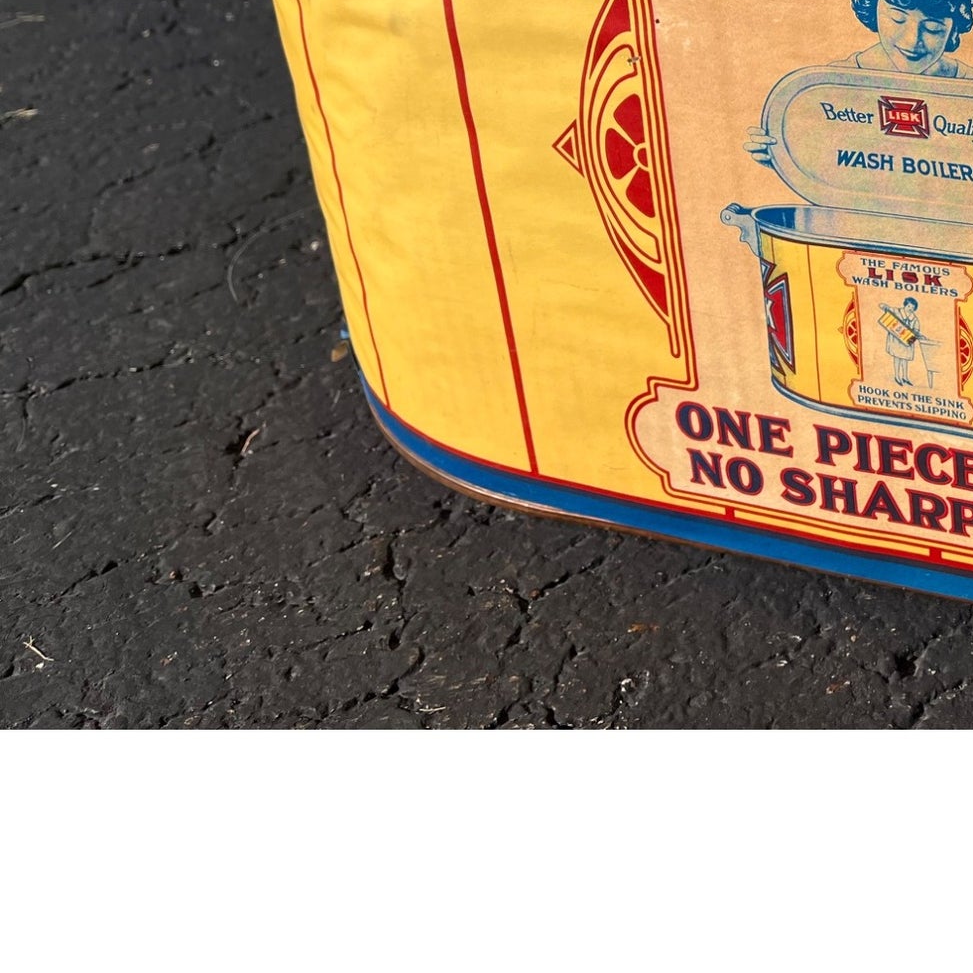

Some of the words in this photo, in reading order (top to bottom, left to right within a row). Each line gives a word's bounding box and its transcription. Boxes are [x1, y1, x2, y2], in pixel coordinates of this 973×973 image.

[820, 102, 874, 124] Better
[888, 110, 920, 123] LISK
[836, 150, 894, 171] WASH
[861, 258, 885, 268] THE
[892, 262, 950, 276] FAMOUS
[868, 267, 943, 286] LISK
[852, 276, 888, 288] WASH
[894, 282, 959, 297] BOILERS
[858, 395, 912, 410] PREVENTS
[915, 403, 967, 420] SLIPPING
[859, 385, 890, 397] HOOK
[893, 390, 909, 400] ON
[911, 393, 932, 404] THE
[935, 397, 964, 410] SINK
[675, 401, 794, 457] ONE
[687, 448, 764, 496] NO
